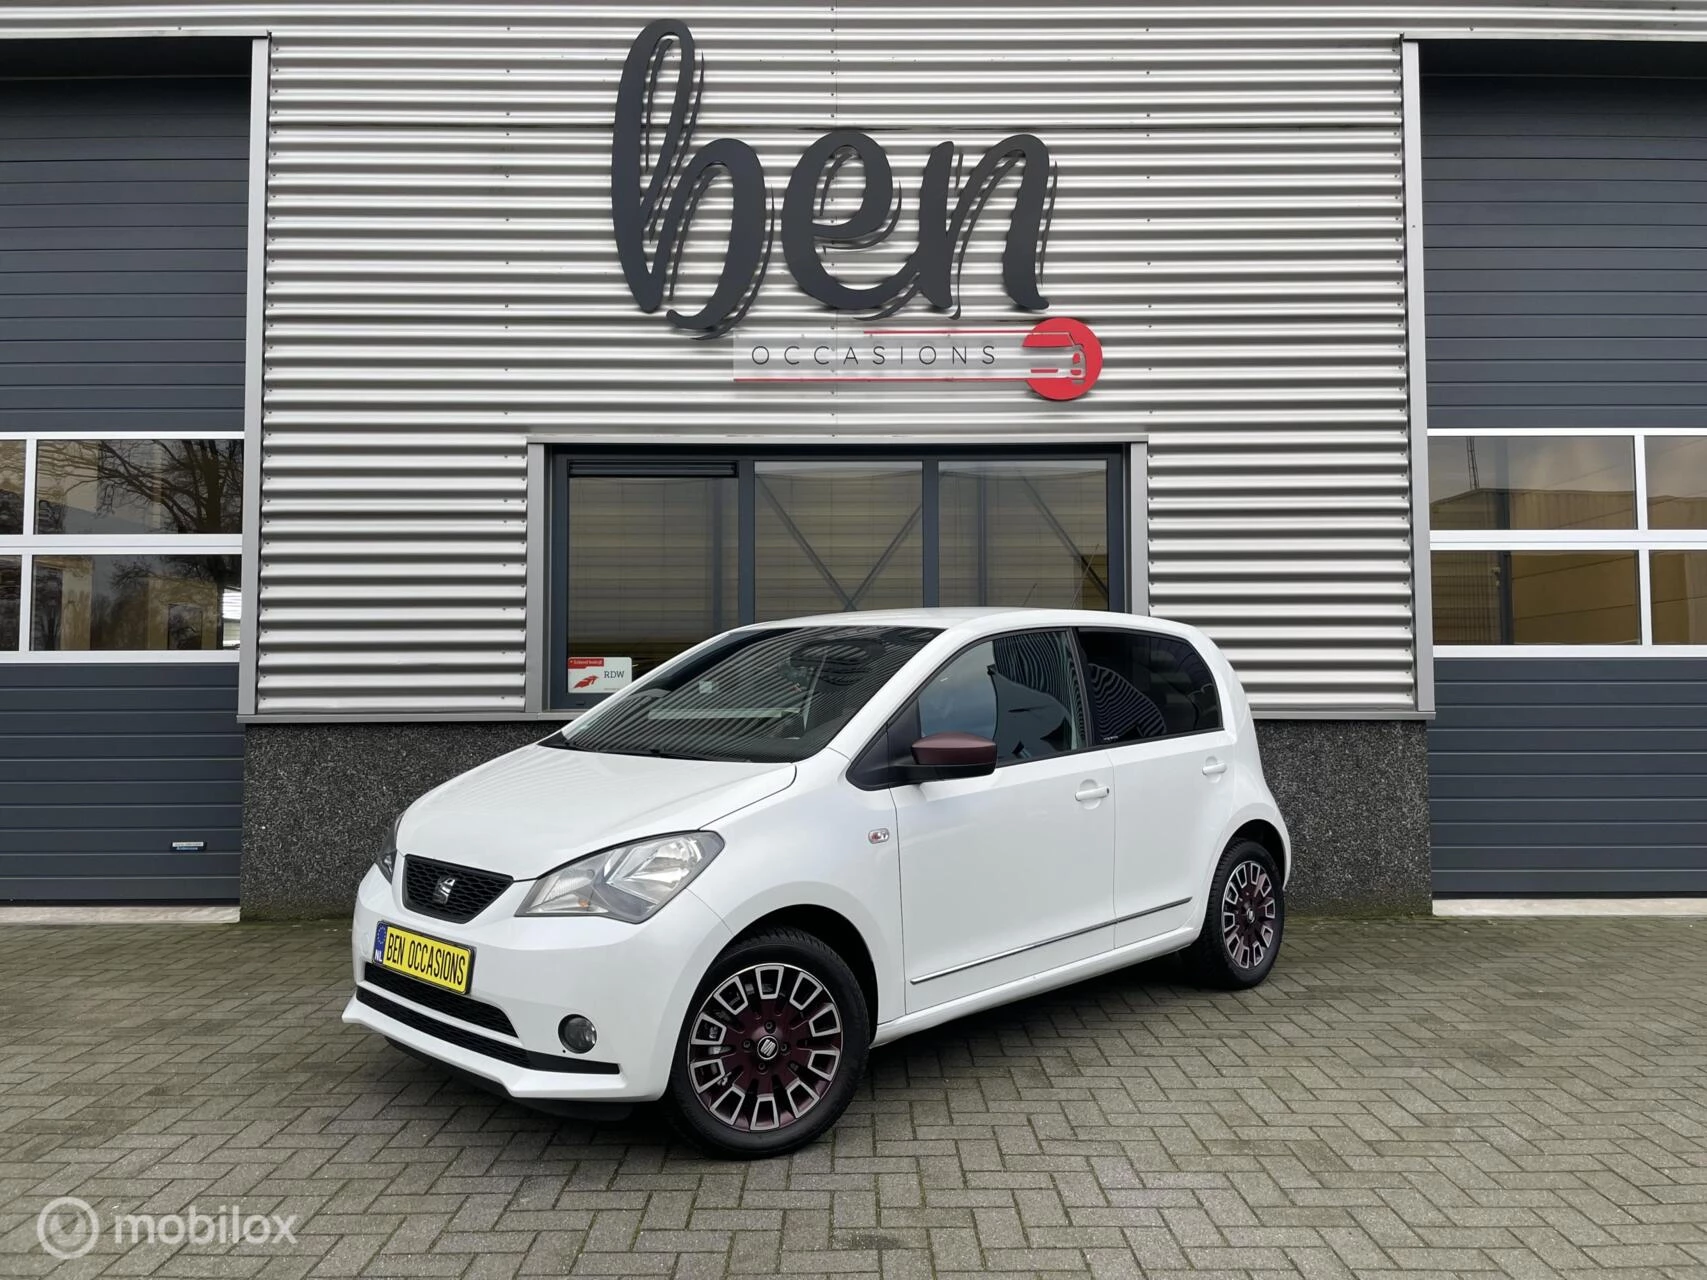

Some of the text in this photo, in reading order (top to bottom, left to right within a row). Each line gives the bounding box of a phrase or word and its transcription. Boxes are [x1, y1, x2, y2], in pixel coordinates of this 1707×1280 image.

[612, 19, 1050, 330] ben
[751, 345, 997, 366] OCCASIONS
[604, 670, 625, 679] RDW
[374, 949, 383, 962] NL
[386, 933, 466, 985] BEN OCCASIONS
